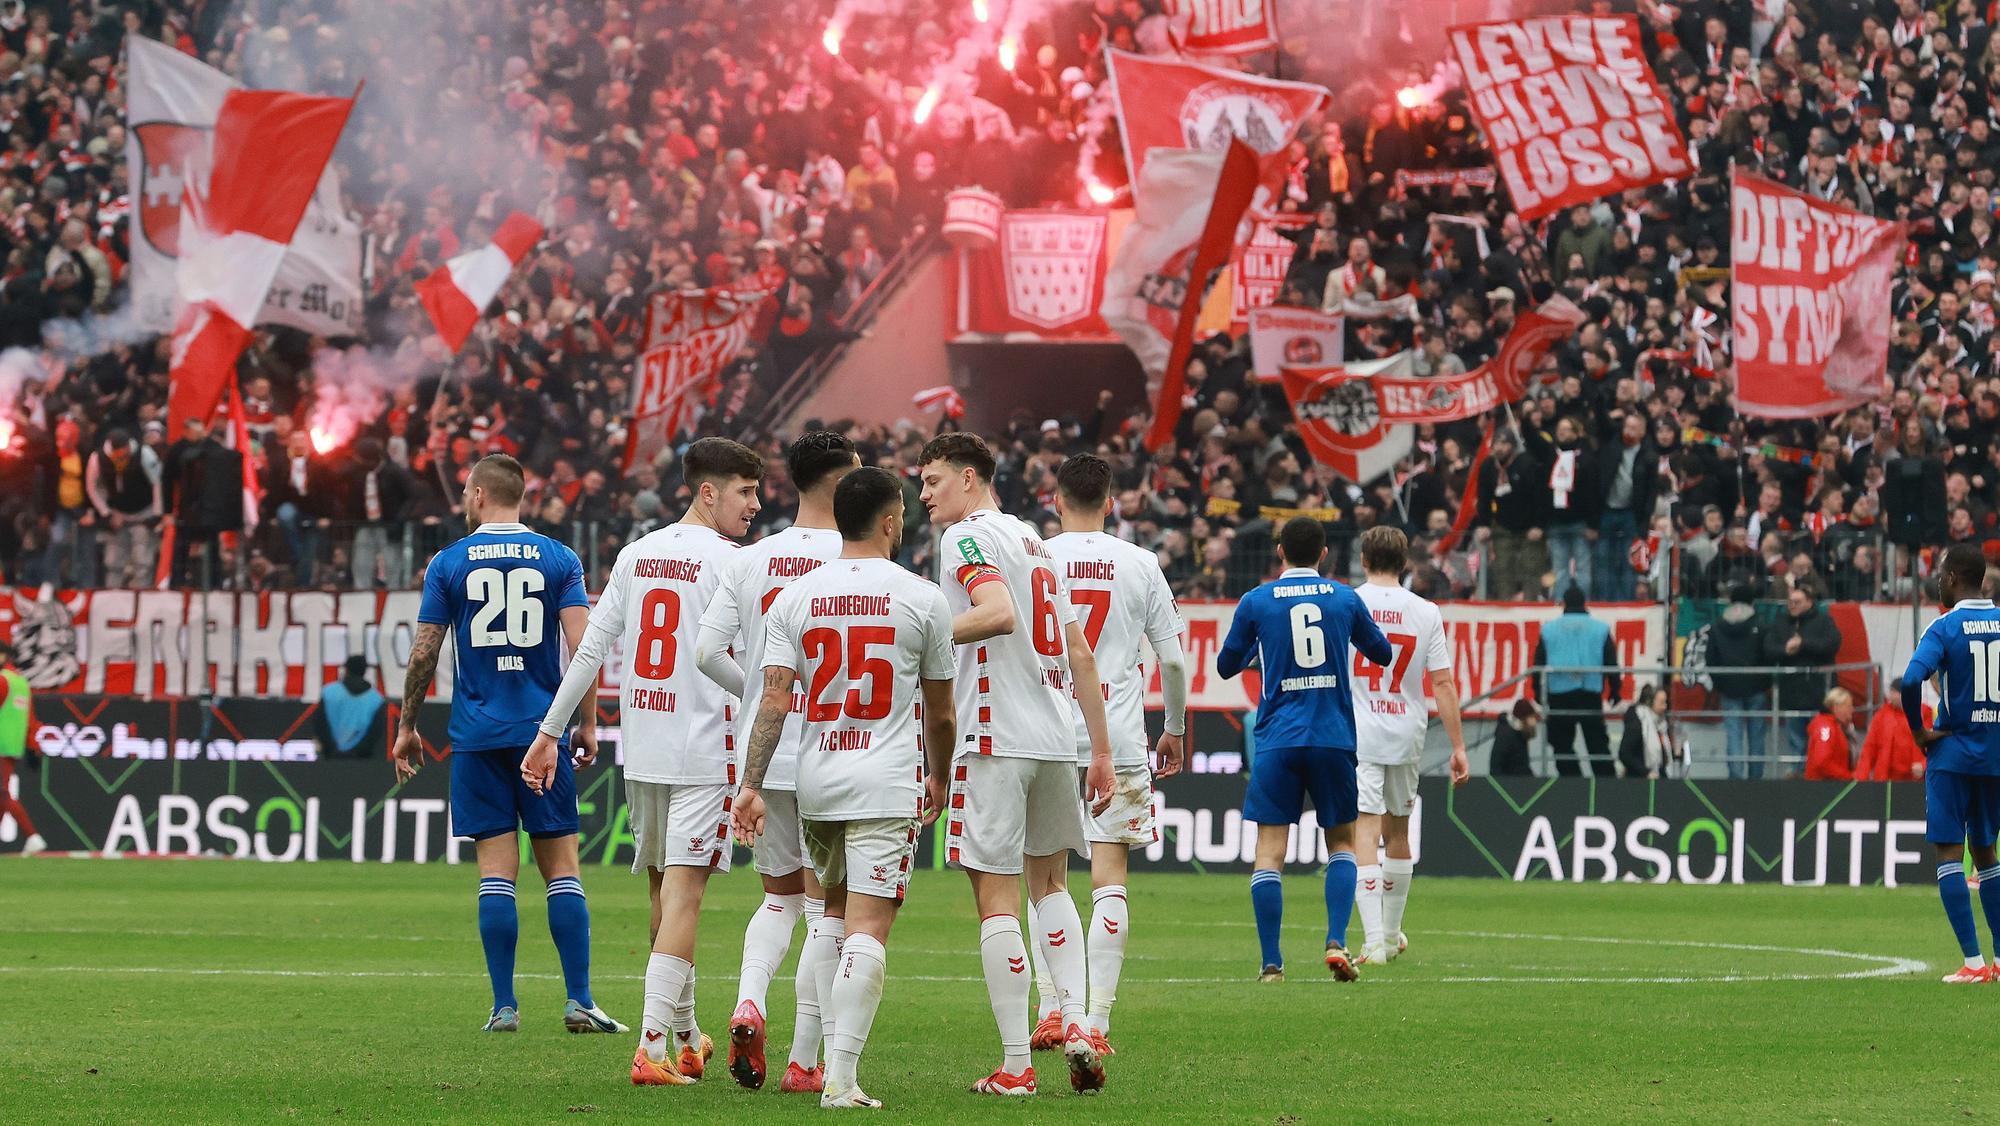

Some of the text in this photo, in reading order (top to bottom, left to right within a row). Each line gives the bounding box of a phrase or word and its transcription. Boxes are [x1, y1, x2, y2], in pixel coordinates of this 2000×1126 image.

[1500, 113, 1688, 211] LOSSE
[468, 543, 541, 561] SCHALKE 04
[1066, 559, 1115, 581] LJUBIČIĆ
[466, 567, 545, 648] 26
[811, 592, 891, 618] GAZIBEGOVIĆ
[1030, 566, 1064, 657] 6
[1070, 589, 1112, 653] 7
[1273, 583, 1334, 599] SCHALKE 04
[84, 588, 453, 703] FRAKTIO
[634, 588, 681, 680] 8
[1290, 602, 1326, 669] 6
[1354, 632, 1417, 694] 47
[649, 688, 676, 713] KÖLN
[802, 626, 896, 722] 25
[839, 726, 872, 751] KÖLN
